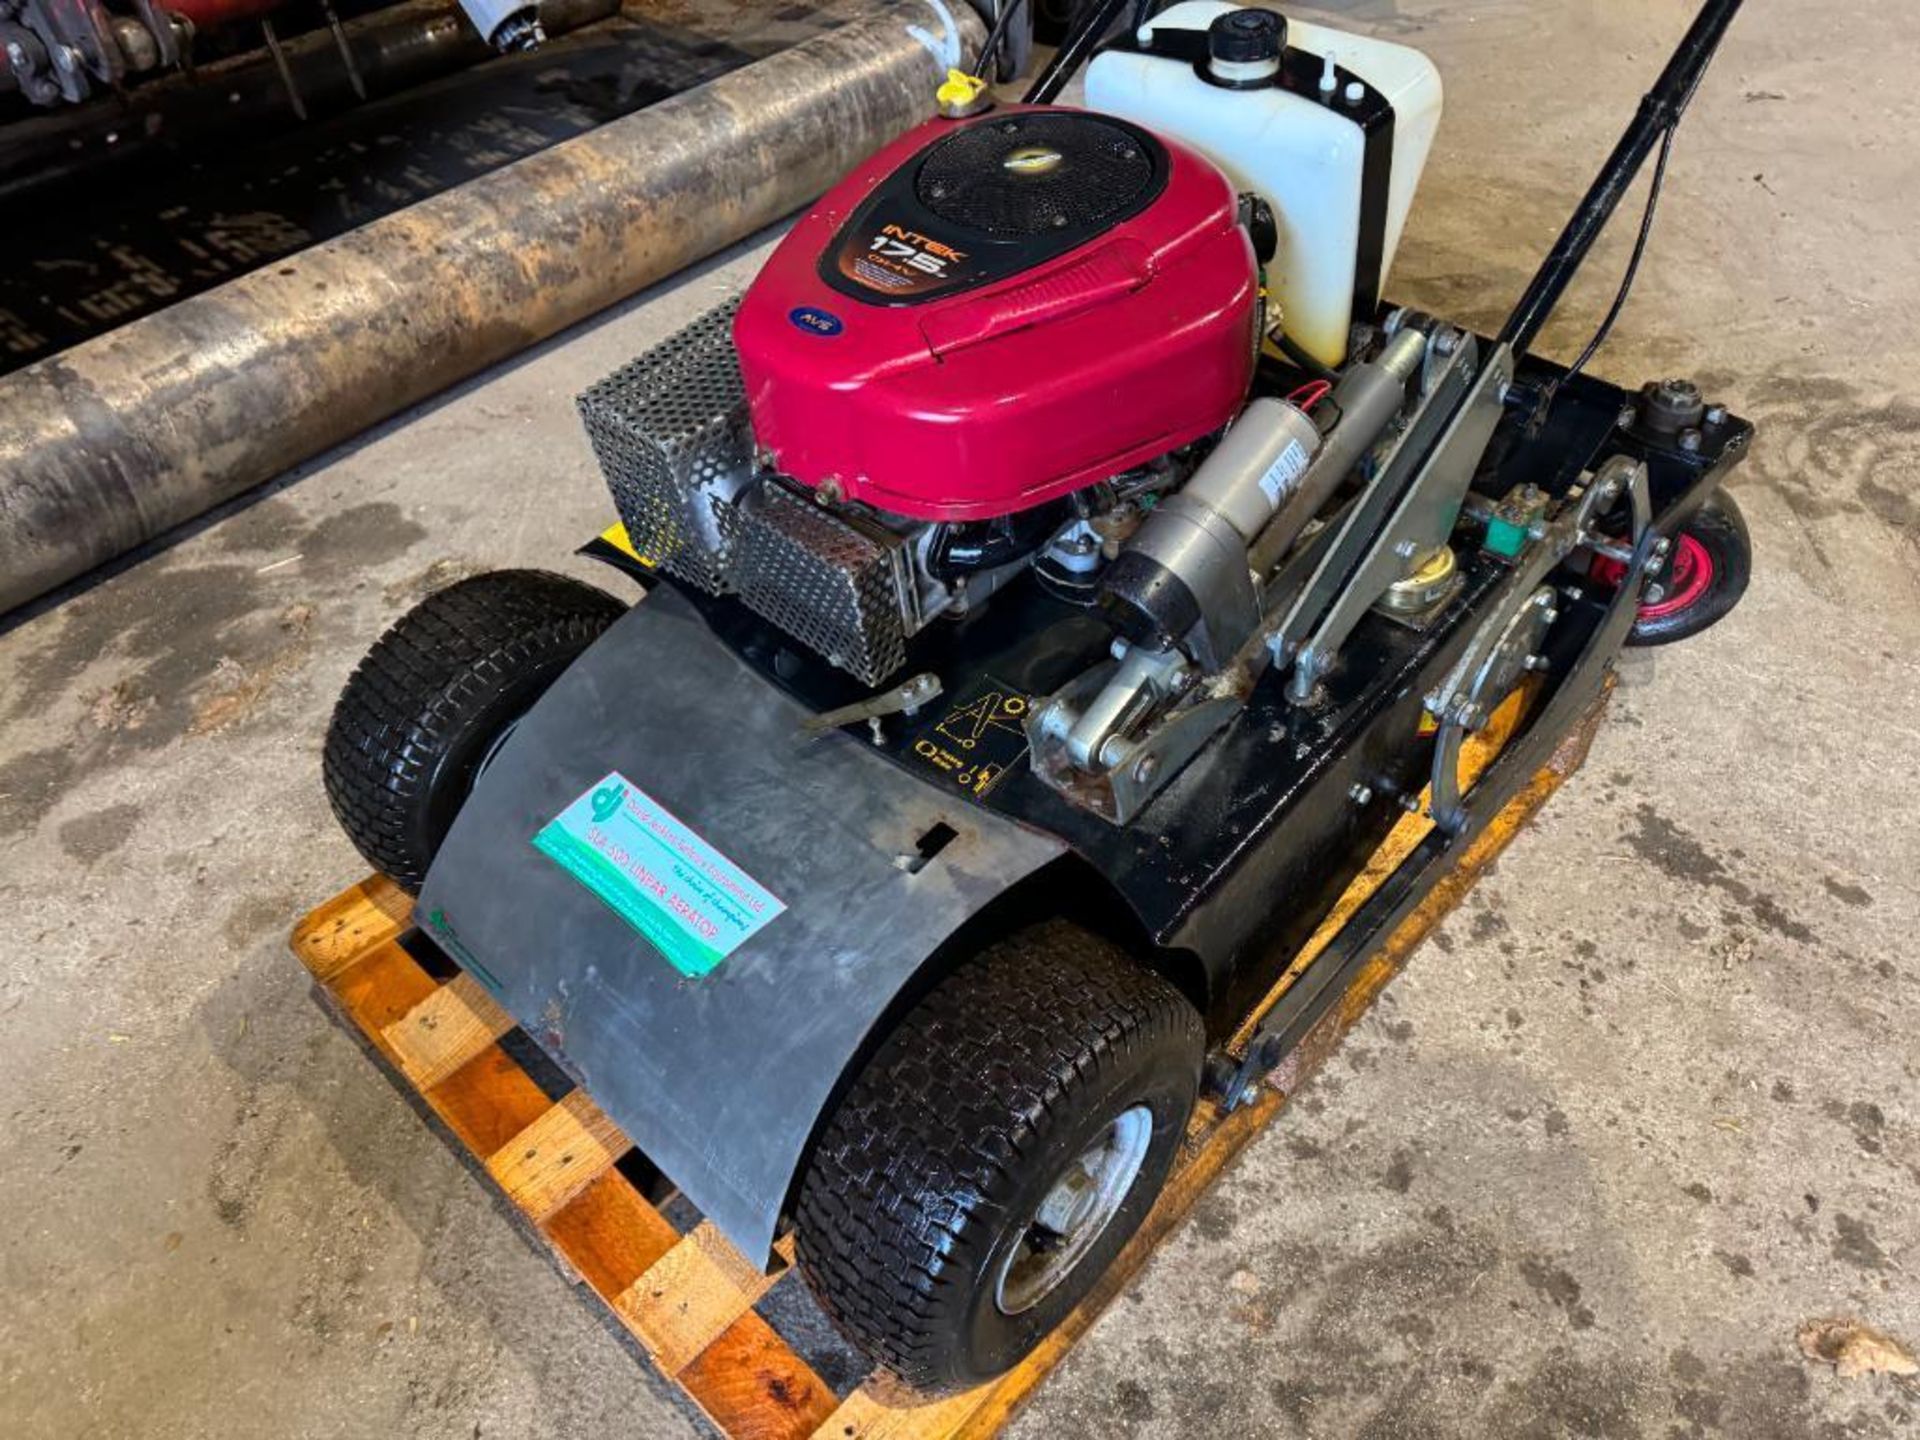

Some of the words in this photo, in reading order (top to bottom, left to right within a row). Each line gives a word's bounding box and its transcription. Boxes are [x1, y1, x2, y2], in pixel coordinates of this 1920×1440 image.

[869, 236, 947, 275] 17.5
[881, 224, 969, 263] INTEK
[631, 864, 666, 896] LINEAR
